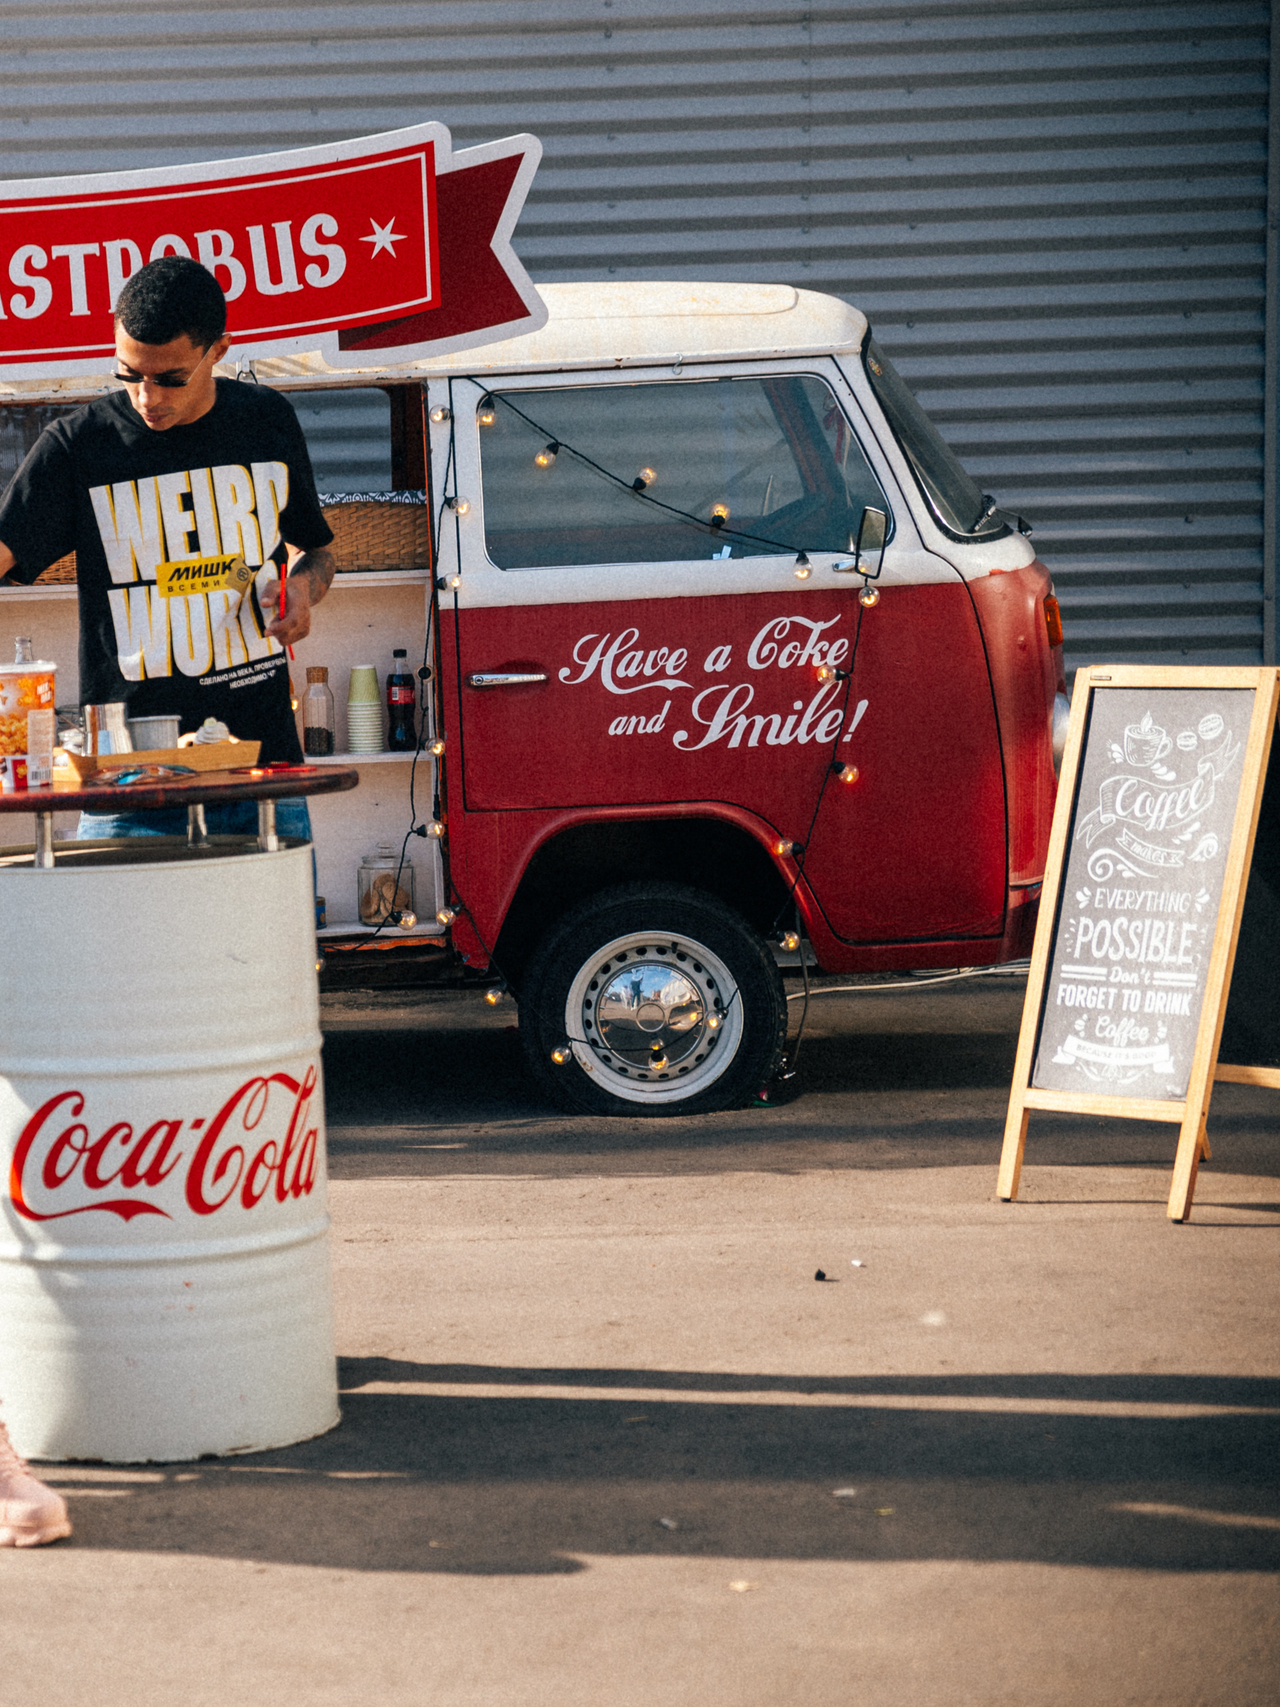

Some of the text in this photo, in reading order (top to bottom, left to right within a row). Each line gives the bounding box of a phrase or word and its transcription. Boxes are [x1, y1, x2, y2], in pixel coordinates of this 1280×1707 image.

[168, 557, 239, 582] МИШК
[558, 613, 850, 695] Have a Coke
[608, 680, 869, 751] and Smile!
[1115, 779, 1206, 831] Coffee
[1094, 887, 1192, 913] EVERYTHING
[1073, 916, 1198, 966] POSSIBLE
[1109, 966, 1151, 985] Don't
[1056, 983, 1193, 1016] FORGET TO DRINK
[1095, 1015, 1150, 1047] Coffee
[9, 1064, 318, 1223] Coca-Cola
